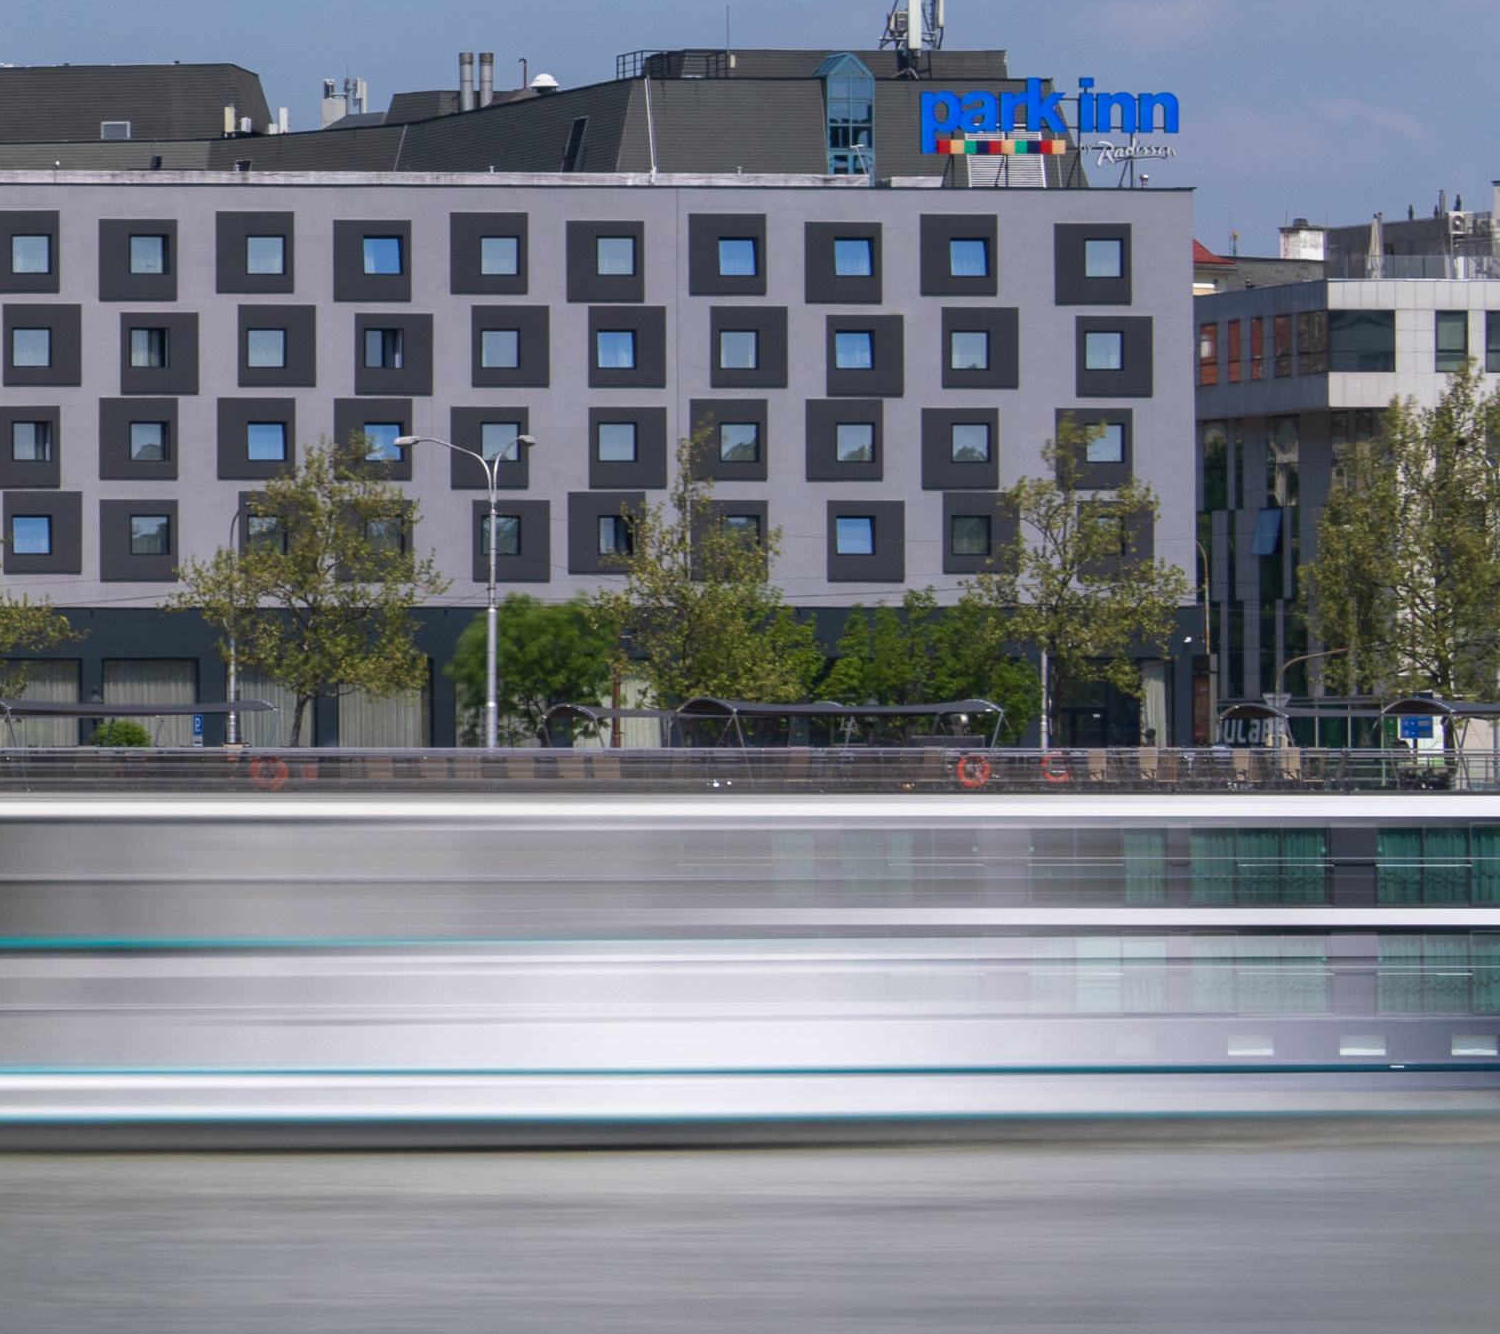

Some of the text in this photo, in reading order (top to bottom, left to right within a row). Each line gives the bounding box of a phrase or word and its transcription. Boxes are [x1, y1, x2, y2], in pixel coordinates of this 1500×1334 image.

[921, 77, 1179, 154] park inn
[1097, 137, 1178, 167] Radisson
